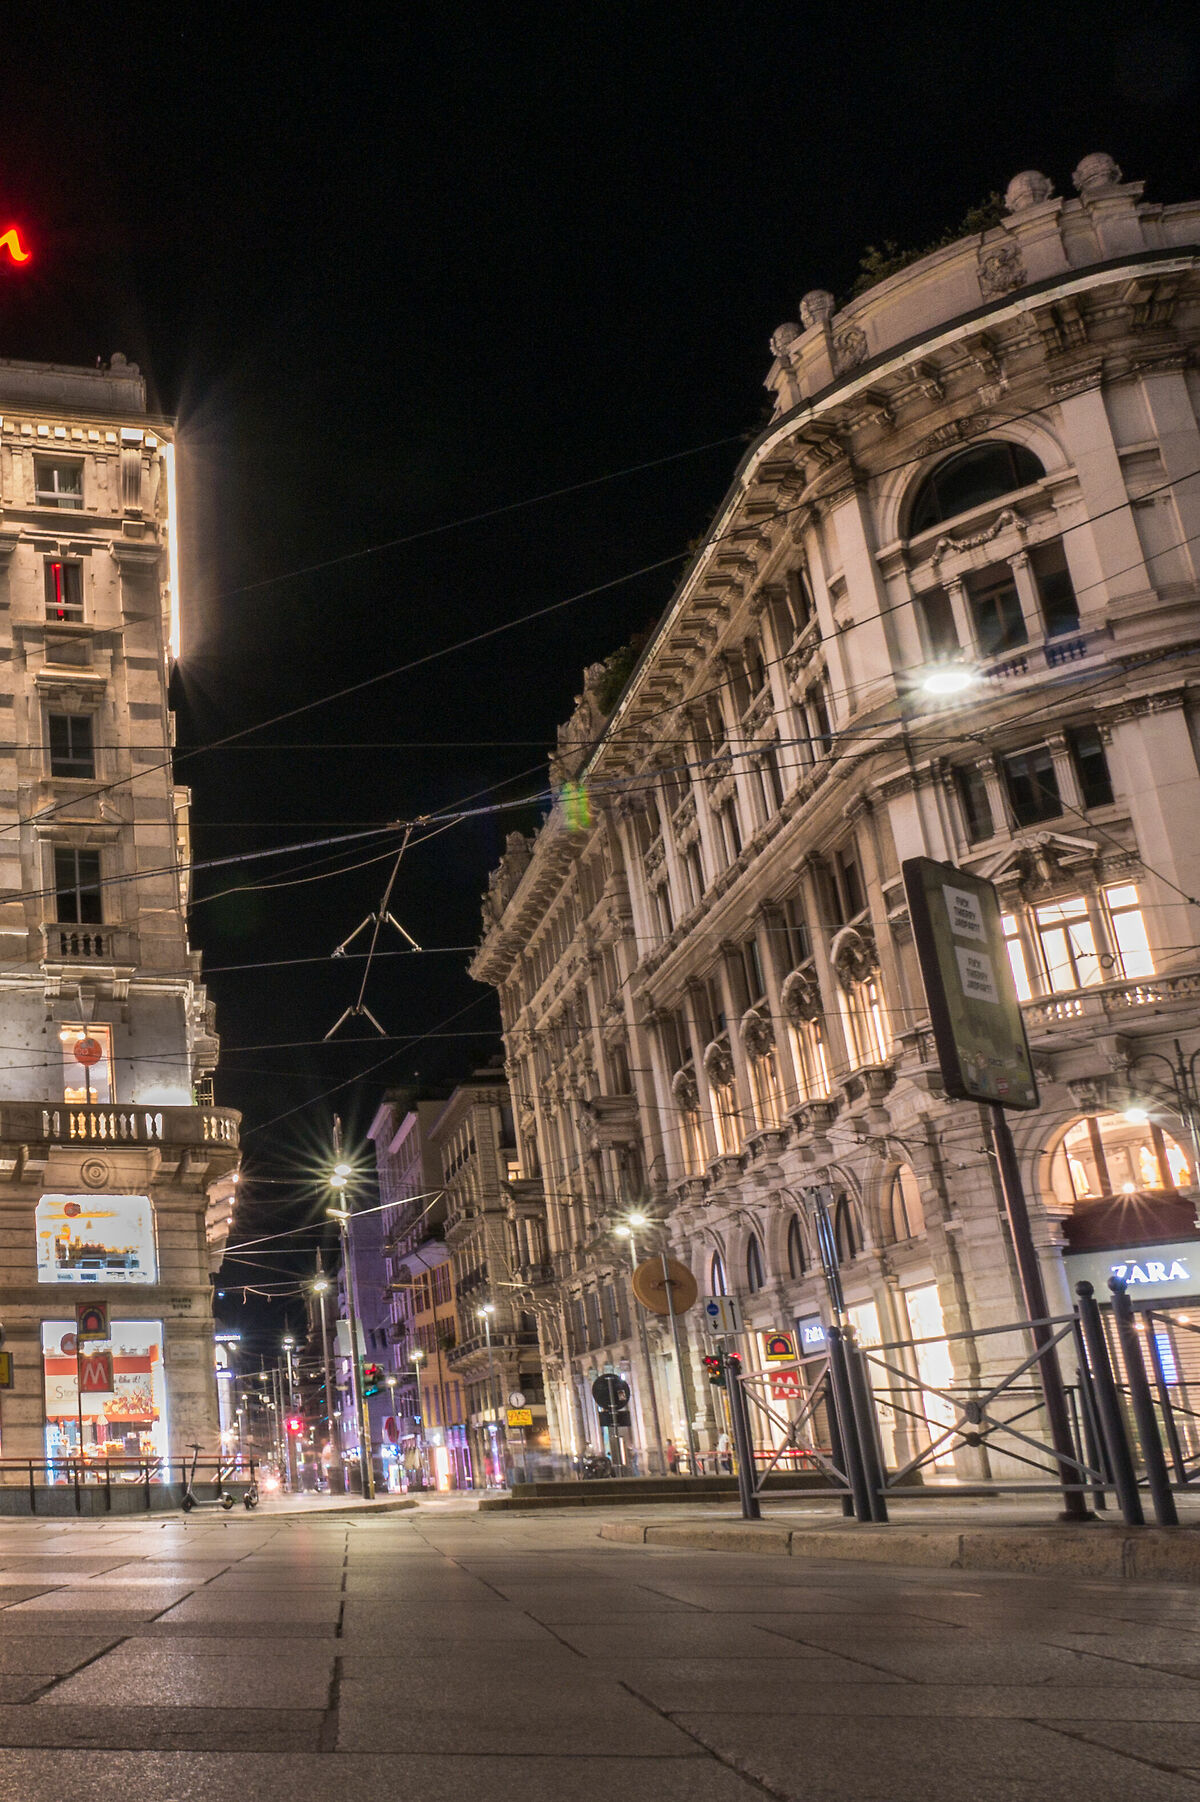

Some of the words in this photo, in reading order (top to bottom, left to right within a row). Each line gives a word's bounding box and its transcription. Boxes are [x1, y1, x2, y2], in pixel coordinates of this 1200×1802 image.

[1111, 1261, 1190, 1283] ZARA
[83, 1362, 109, 1385] M
[774, 1376, 799, 1395] M
